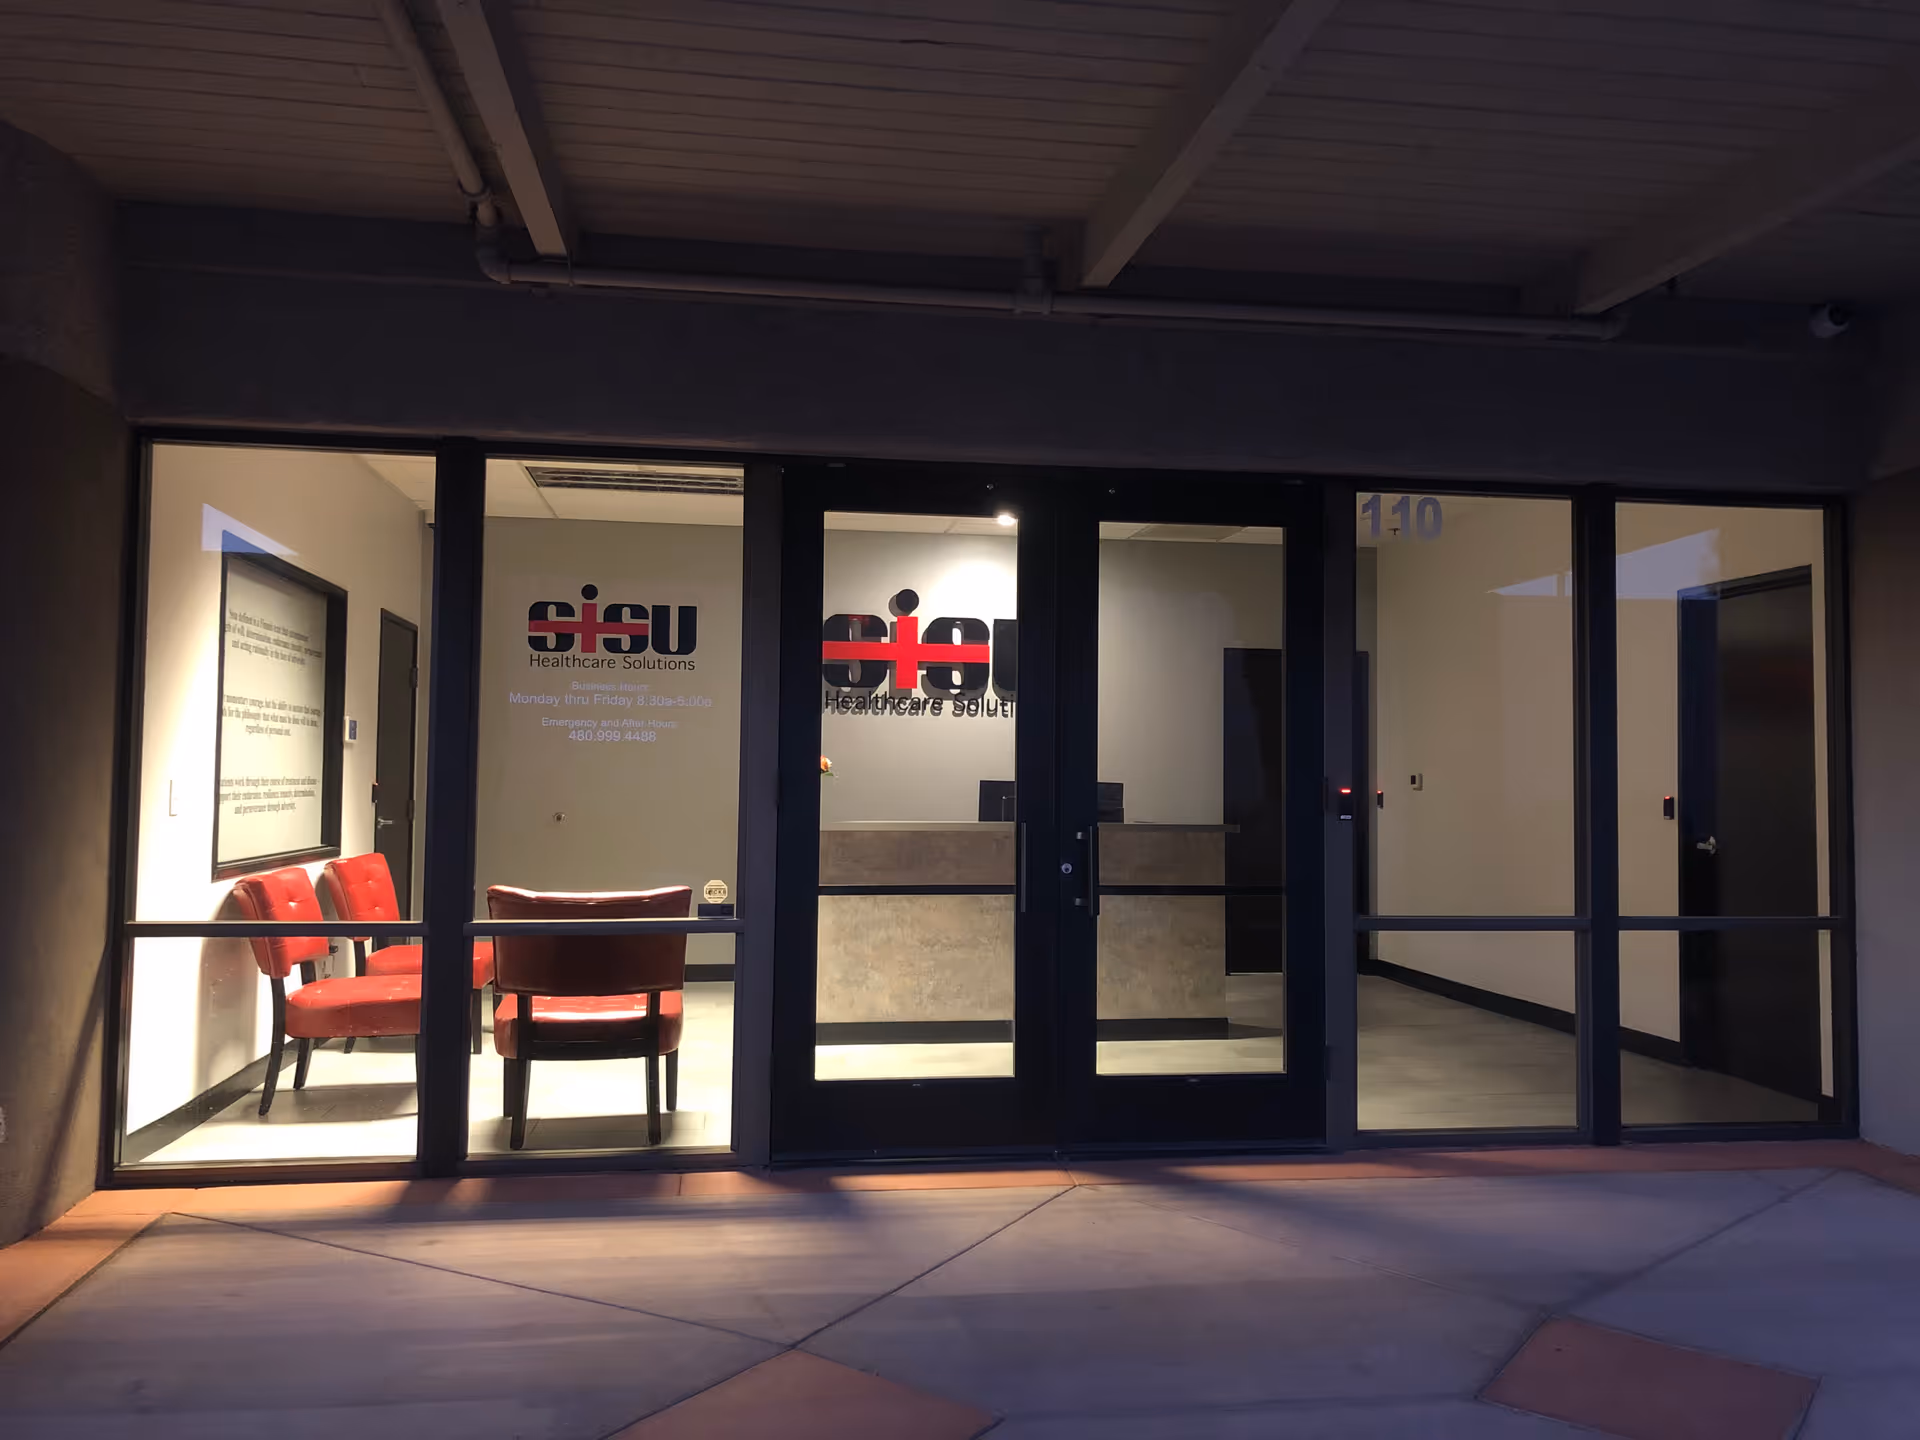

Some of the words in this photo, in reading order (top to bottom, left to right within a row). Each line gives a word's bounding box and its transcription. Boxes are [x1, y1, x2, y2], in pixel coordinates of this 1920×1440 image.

[1361, 494, 1443, 542] 110
[529, 653, 616, 669] Healthcare
[622, 655, 696, 671] Solutions
[509, 691, 561, 708] Monday
[564, 692, 589, 705] thru
[593, 693, 633, 709] Friday
[824, 690, 944, 713] Healthcare
[953, 692, 1016, 715] Soluti
[541, 717, 597, 730] Emergency
[600, 717, 619, 728] and
[621, 718, 644, 729] After
[568, 729, 657, 743] 480.999.4488
